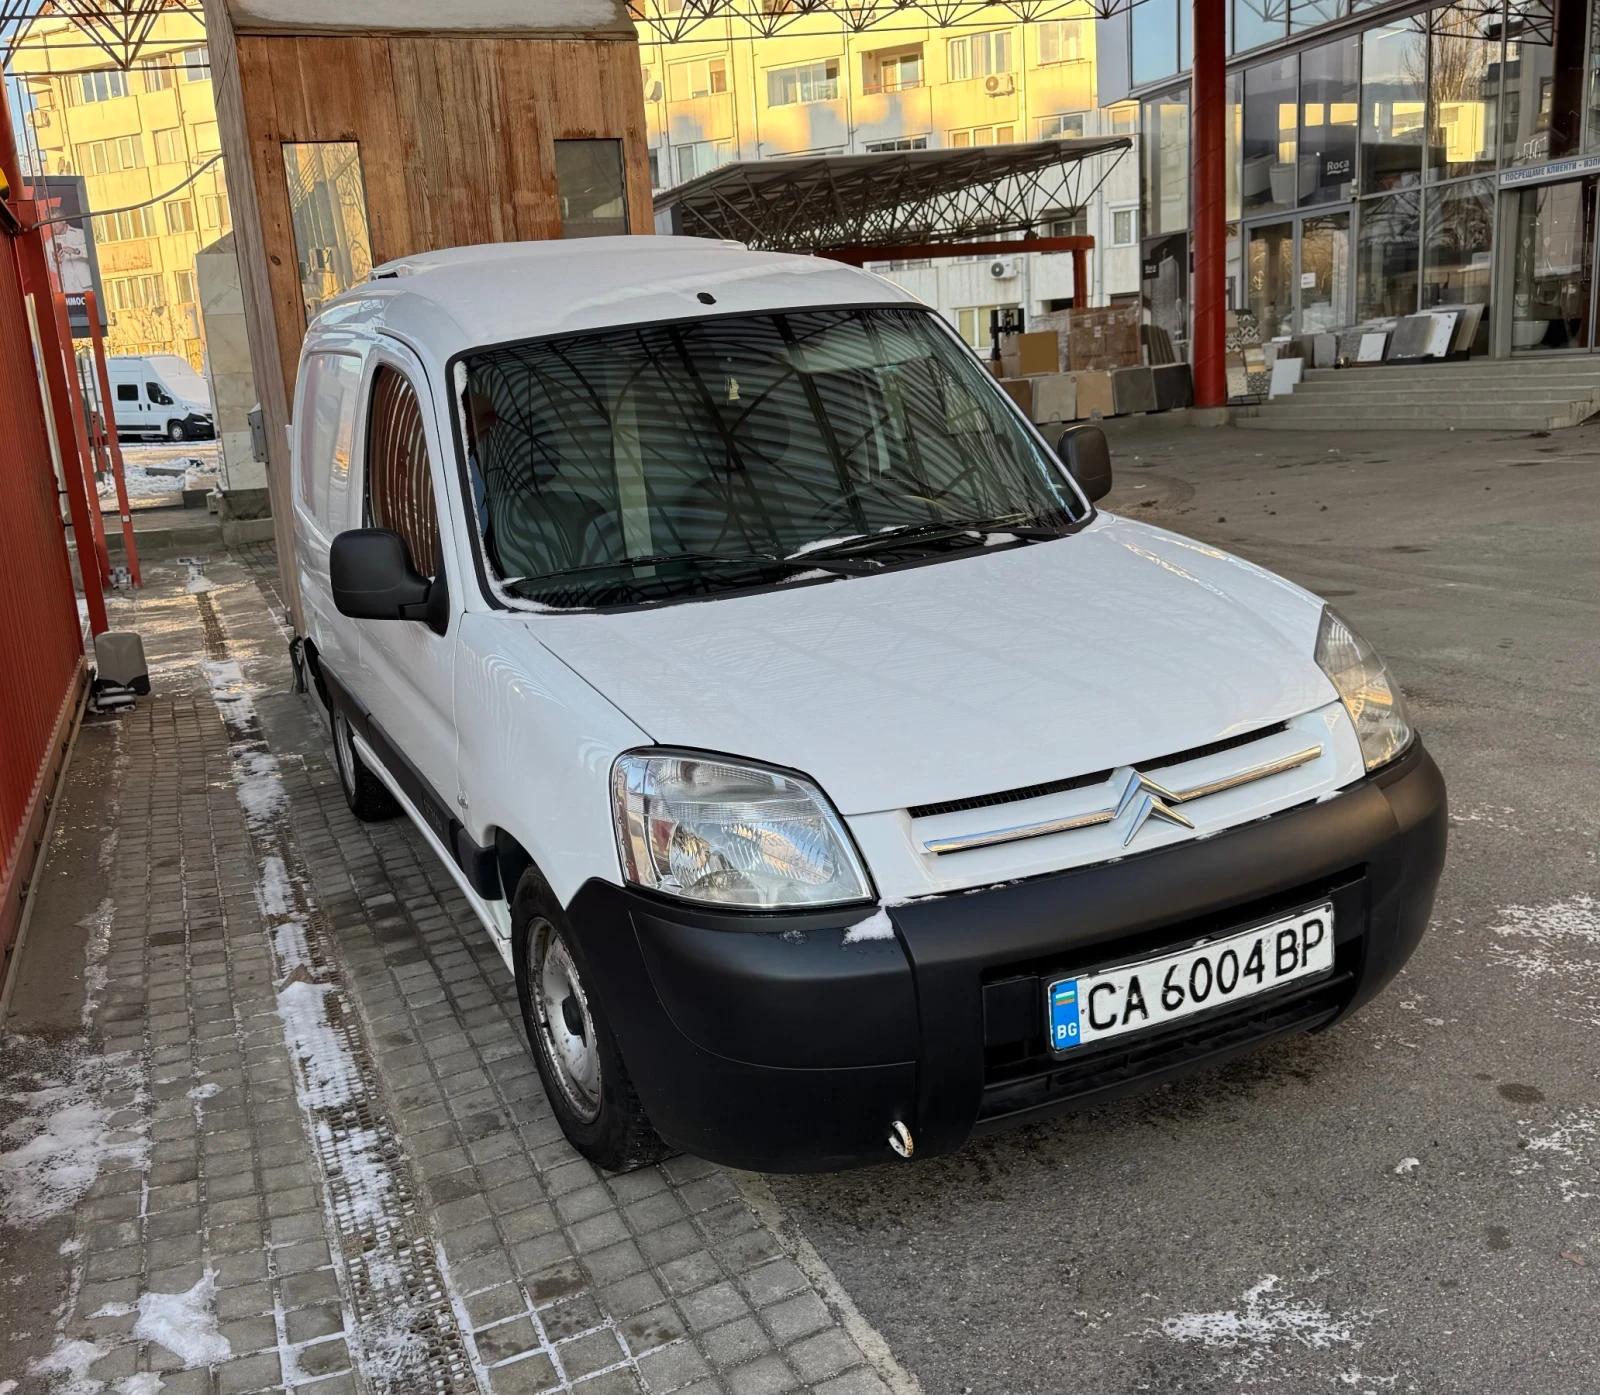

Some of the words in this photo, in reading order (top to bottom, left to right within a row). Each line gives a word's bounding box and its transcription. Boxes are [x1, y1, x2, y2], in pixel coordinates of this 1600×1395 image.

[1327, 160, 1350, 171] Roca
[1505, 167, 1545, 181] ПОСРЕЩАМЕ
[1546, 162, 1577, 174] КЛИЕНТИ
[1057, 1022, 1078, 1040] BG
